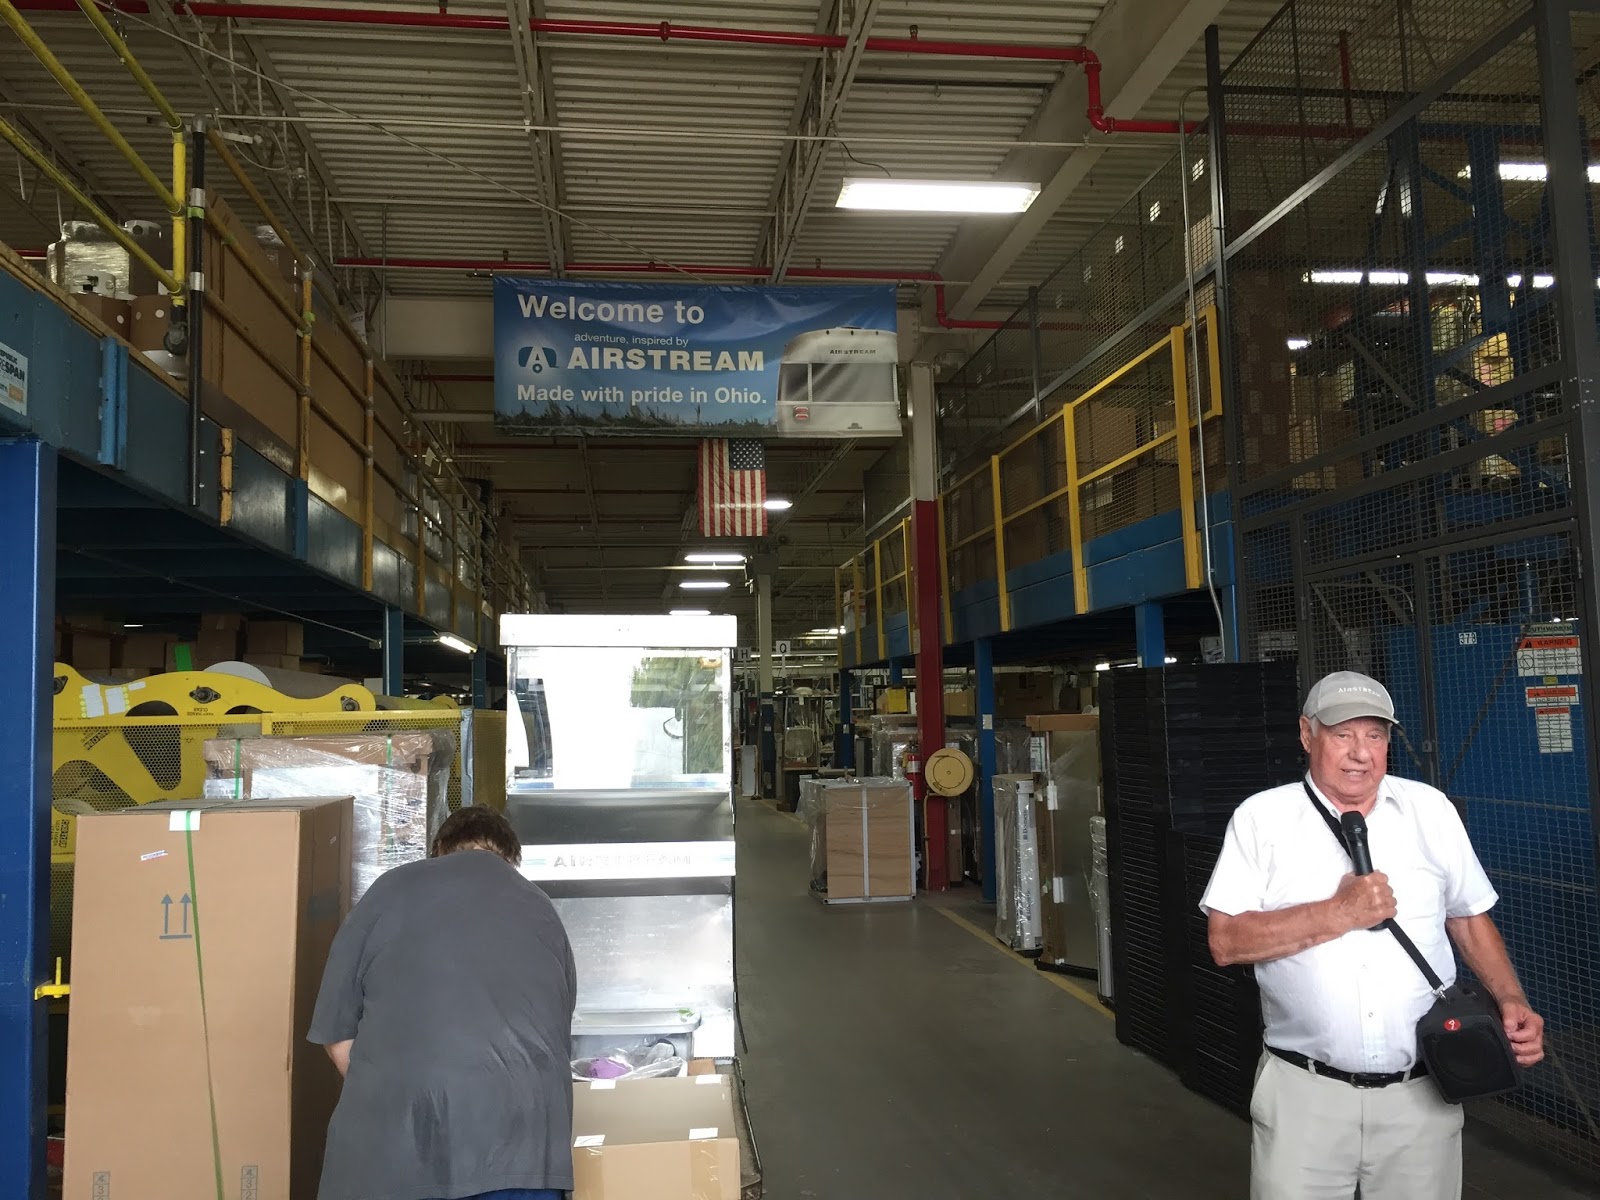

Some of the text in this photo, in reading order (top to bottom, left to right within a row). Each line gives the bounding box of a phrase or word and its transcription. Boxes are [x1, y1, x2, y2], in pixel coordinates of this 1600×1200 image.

[517, 294, 705, 324] Welcome to
[574, 333, 689, 348] adventure, inspired by
[567, 346, 765, 371] AIRSTREAM
[517, 384, 767, 406] Made with pride in Ohio.
[741, 649, 748, 658] H
[779, 643, 787, 653] Q
